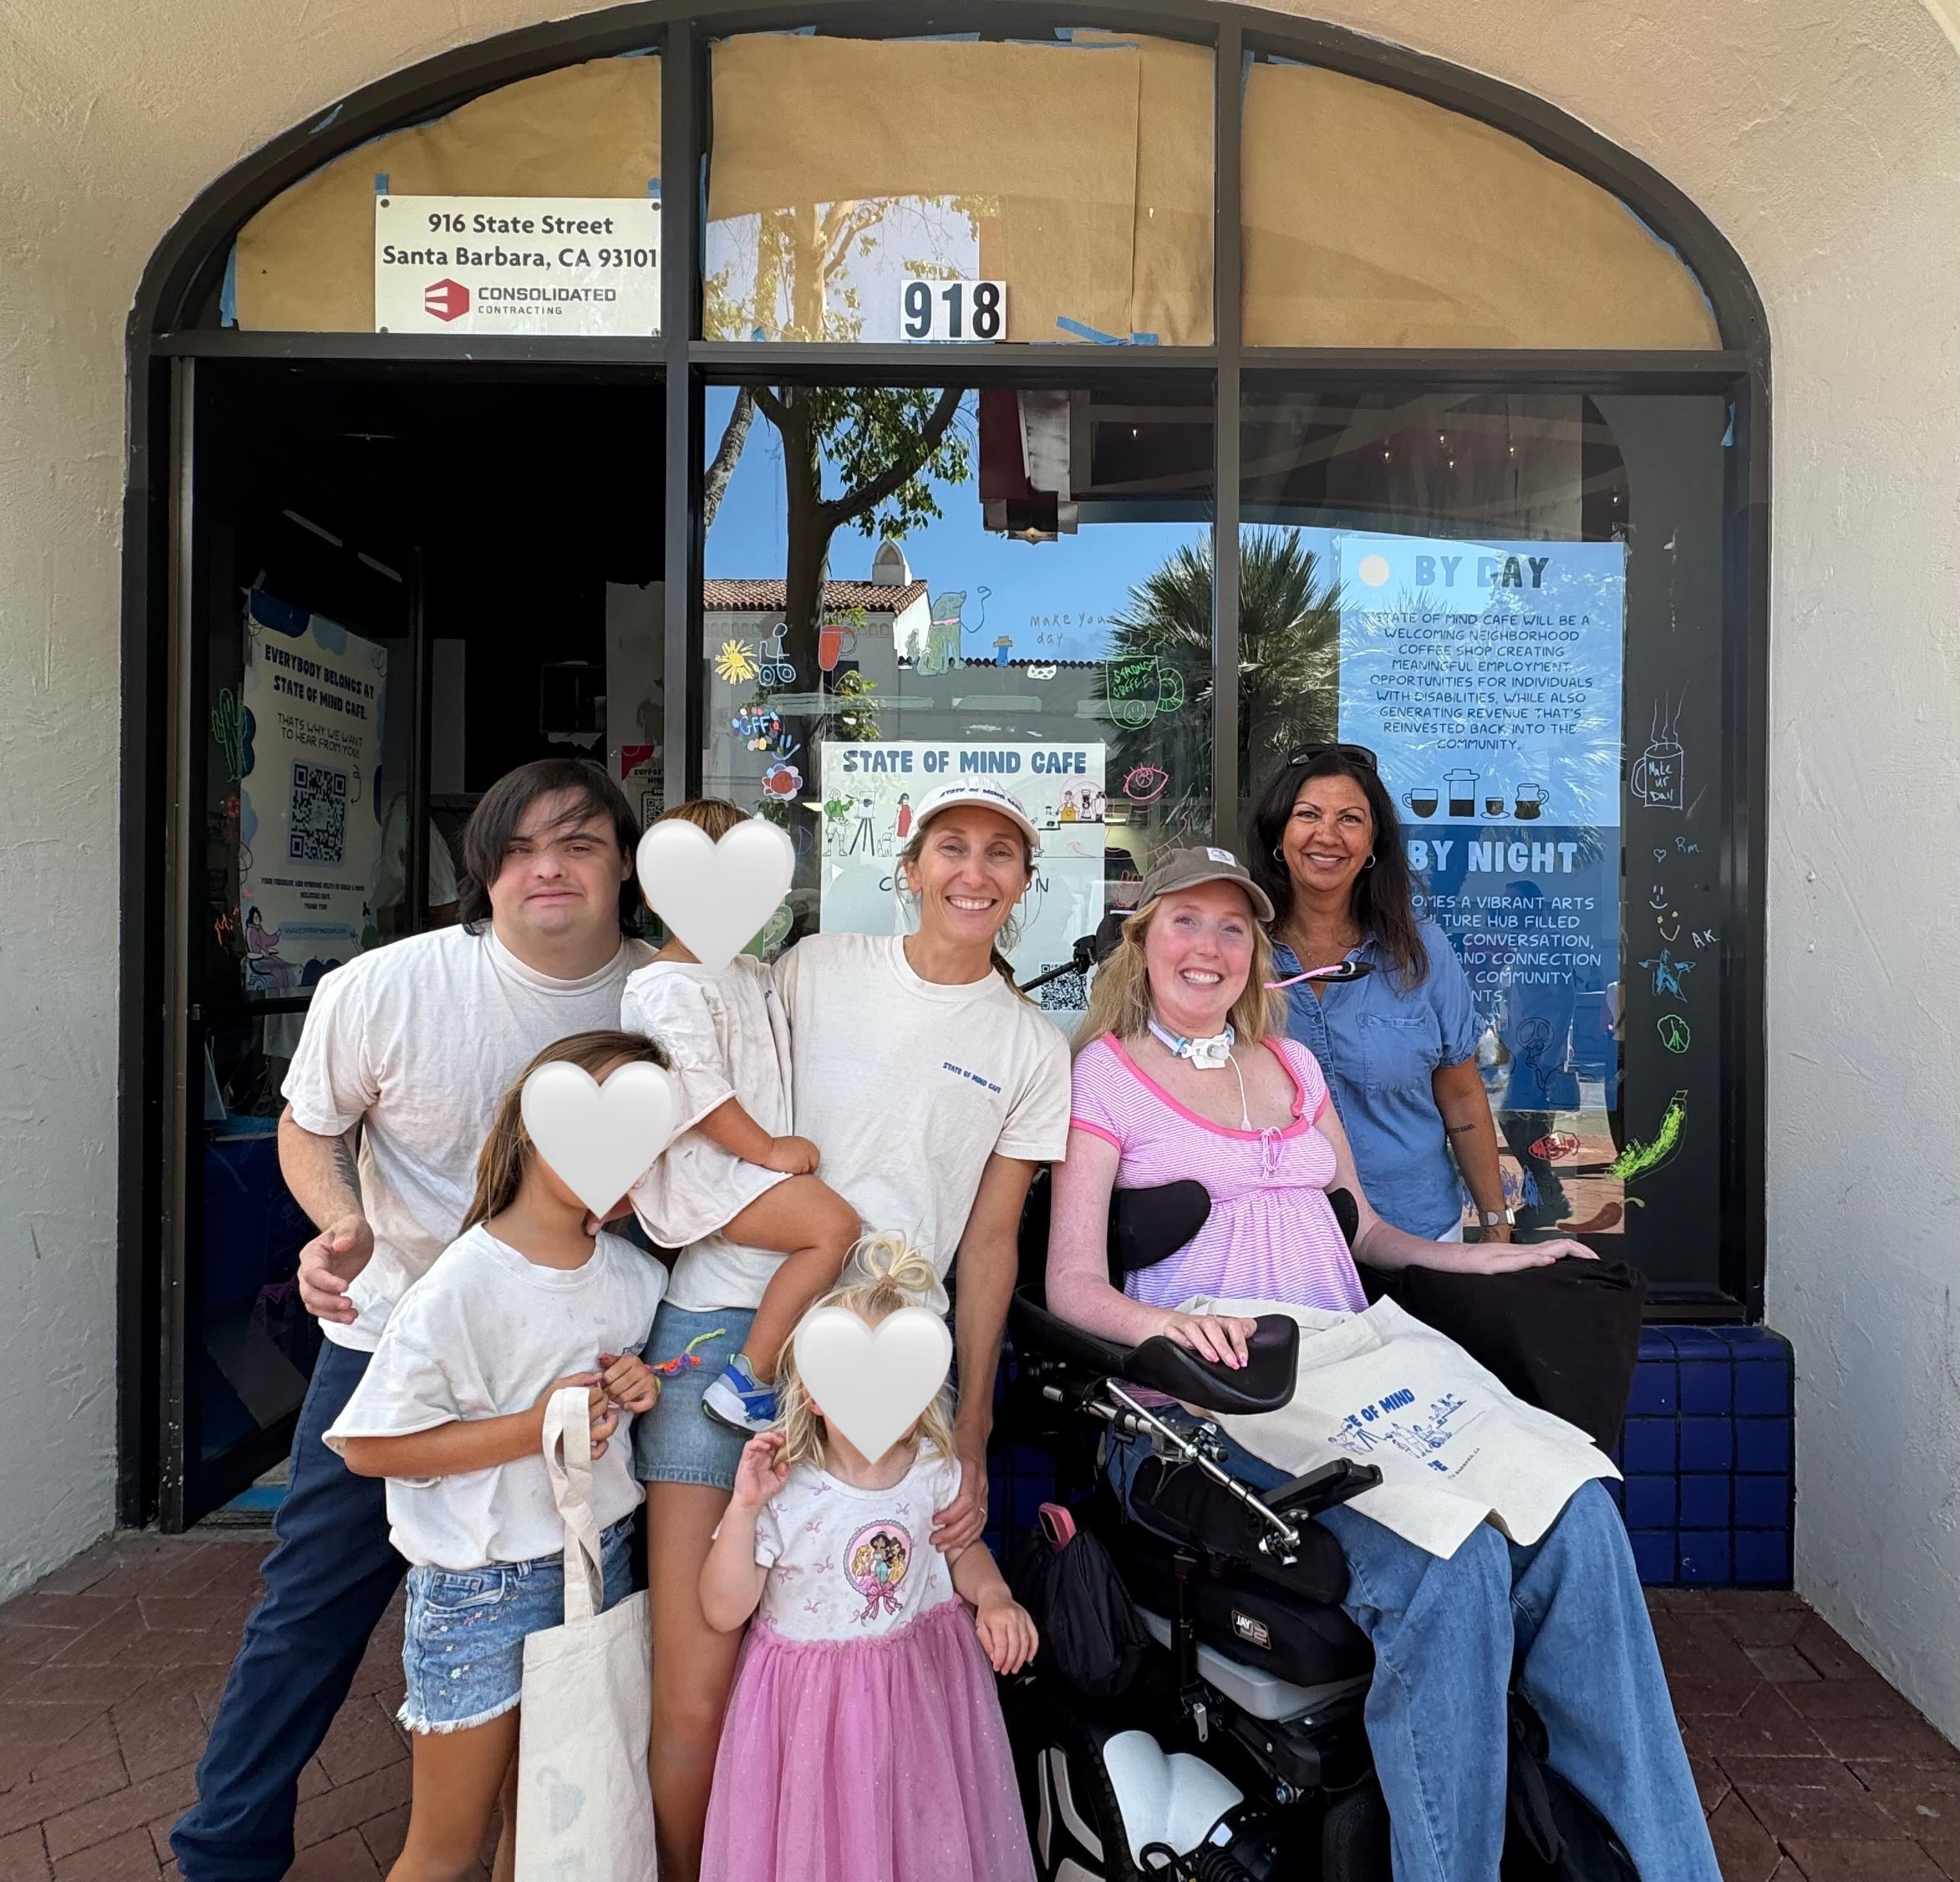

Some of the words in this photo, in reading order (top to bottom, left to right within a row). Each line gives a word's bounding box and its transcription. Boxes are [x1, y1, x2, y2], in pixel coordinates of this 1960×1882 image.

[428, 213, 465, 233] 916
[473, 214, 535, 234] State
[542, 215, 614, 235] Street
[383, 246, 448, 266] Santa
[456, 246, 552, 271] Barbara,
[558, 248, 591, 268] CA
[598, 248, 657, 268] 93101
[478, 287, 617, 302] CONSOLIDATED
[478, 306, 563, 316] CONTRACTING
[905, 282, 1000, 339] 918
[1415, 555, 1463, 587] BY
[1477, 556, 1549, 588] DAY
[1376, 612, 1417, 624] STATE
[1422, 613, 1440, 624] OF
[1446, 614, 1478, 625] MIND
[1483, 614, 1517, 626] CAFE
[1522, 615, 1552, 626] WILL
[1560, 616, 1576, 626] BE
[1582, 616, 1590, 626] A
[1384, 628, 1465, 641] WELCOMING
[1470, 629, 1579, 642] NEIGHBORHOOD
[1399, 644, 1451, 656] COFFEE
[1457, 645, 1492, 657] SHOP
[1497, 646, 1564, 657] CREATING
[265, 644, 322, 679] EVERYBODY
[324, 668, 362, 695] BELONGS
[364, 683, 374, 700] AT
[1392, 660, 1473, 672] MEANINGFUL
[1478, 661, 1570, 673] EMPLOYMENT
[1370, 674, 1473, 687] OPPORTUNITIES
[1478, 676, 1506, 688] FOR
[1512, 676, 1593, 688] INDIVIDUALS
[274, 675, 304, 699] STATE
[307, 687, 317, 703] OF
[320, 691, 343, 711] MIND
[345, 703, 367, 720] CAFE.
[1376, 691, 1410, 703] WITH
[1415, 692, 1498, 705] DISABILITIES,
[1504, 693, 1545, 703] WHILE
[1550, 693, 1585, 703] ALSO
[1380, 707, 1463, 719] GENERATING
[1468, 708, 1528, 719] REVENUE
[1536, 708, 1582, 719] THAT'S
[307, 722, 325, 736] WHY
[328, 727, 339, 740] WE
[342, 732, 363, 747] WANT
[1383, 722, 1465, 734] REINVESTED
[1470, 723, 1504, 734] BACK
[1512, 724, 1545, 734] INTO
[1550, 724, 1576, 734] THE
[281, 727, 294, 739] TO
[296, 732, 317, 747] HEAR
[319, 739, 340, 752] FROM
[1437, 739, 1521, 750] COMMUNITY.
[843, 750, 912, 773] STATE
[923, 751, 949, 773] OF
[960, 751, 1021, 774] MIND
[1031, 752, 1087, 774] CAFE
[1407, 840, 1453, 871] BY
[1468, 841, 1577, 873] NIGHT
[1411, 895, 1455, 908] OMES
[1461, 896, 1471, 908] A
[1477, 896, 1545, 909] VIBRANT
[1550, 897, 1594, 910] ARTS
[1488, 915, 1519, 927] HUB
[1524, 916, 1580, 929] FILLED
[1463, 934, 1594, 950] CONVERSATION,
[1492, 953, 1601, 966] CONNECTION
[1475, 971, 1572, 984] COMMUNITY
[1471, 990, 1507, 1003] NTS.
[942, 1062, 962, 1075] STATE
[1361, 1404, 1379, 1421] OF
[1379, 1388, 1415, 1414] MIND
